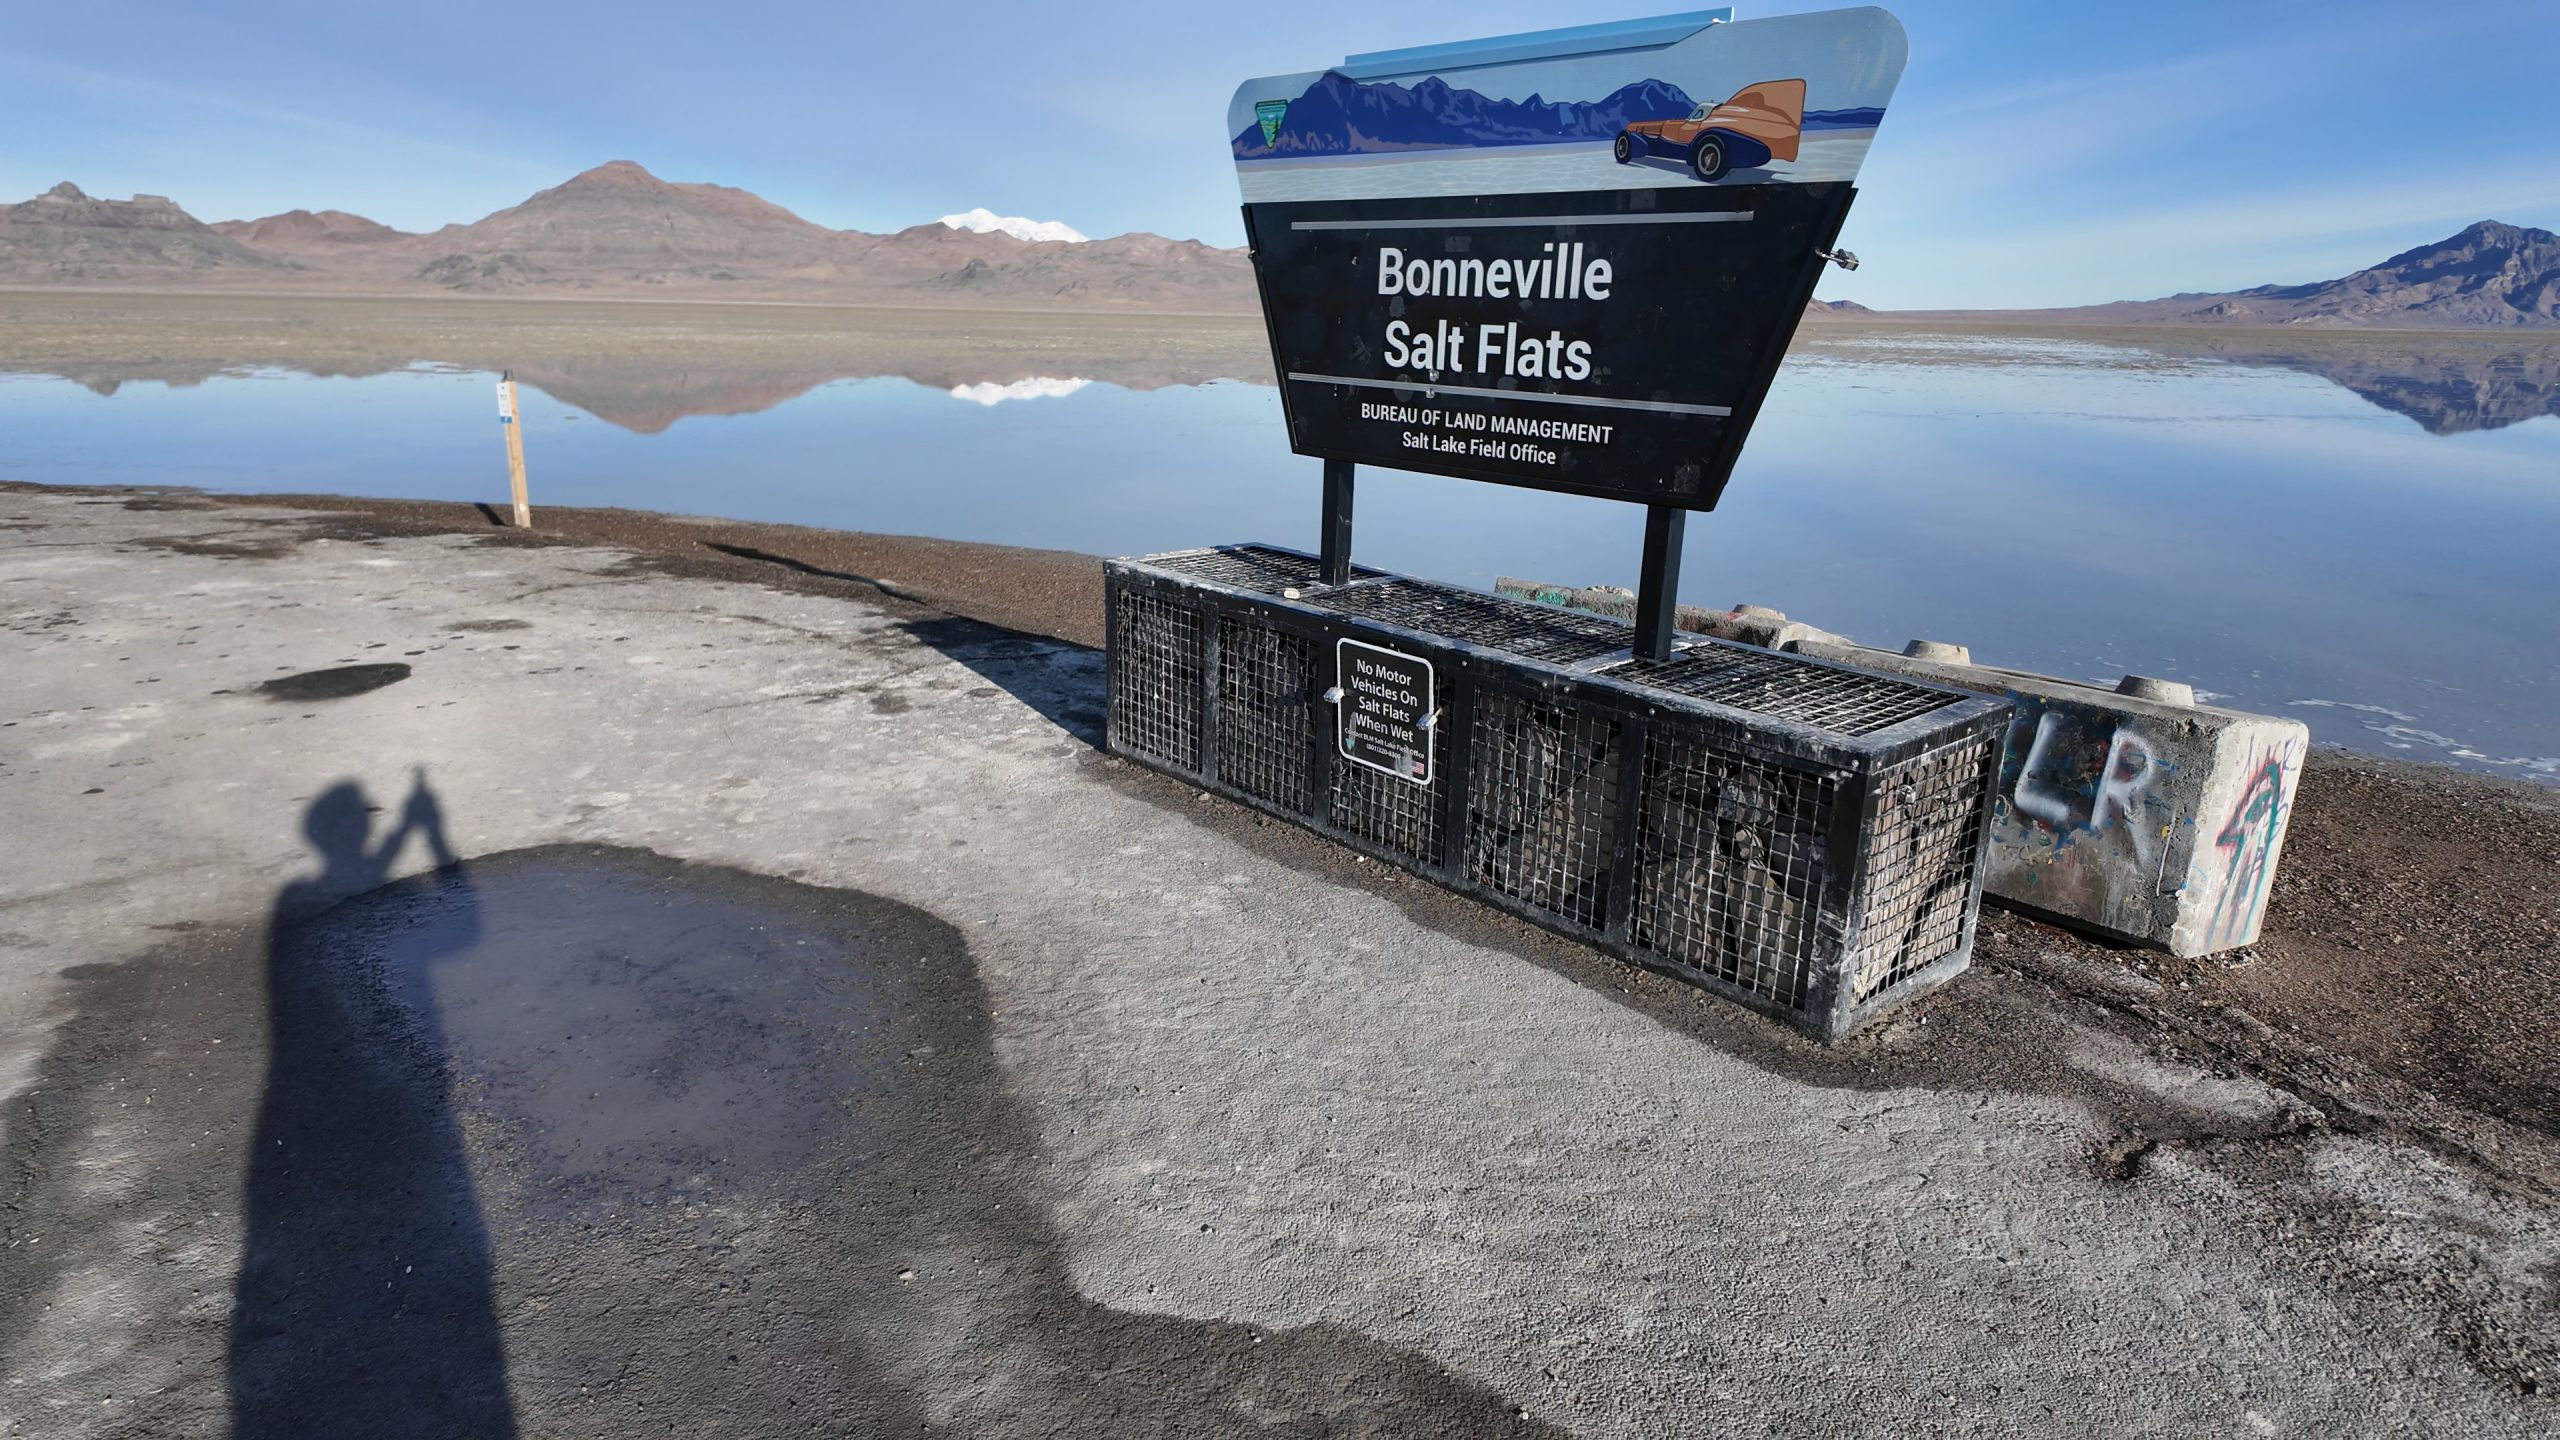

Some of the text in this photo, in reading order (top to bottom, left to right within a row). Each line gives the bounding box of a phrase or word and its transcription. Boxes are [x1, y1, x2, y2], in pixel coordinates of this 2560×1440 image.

[1377, 242, 1613, 301] Bonneville
[1383, 319, 1593, 382] Salt Flats
[1361, 402, 1613, 445] BUREAU OF LAND MANAGEMENT
[1402, 431, 1557, 465] Salt Lake Field Office
[1356, 659, 1412, 686] No Motor
[1351, 675, 1418, 707] Vehicles On
[1358, 695, 1410, 723] Salt Flats
[1355, 712, 1414, 743] When Wet
